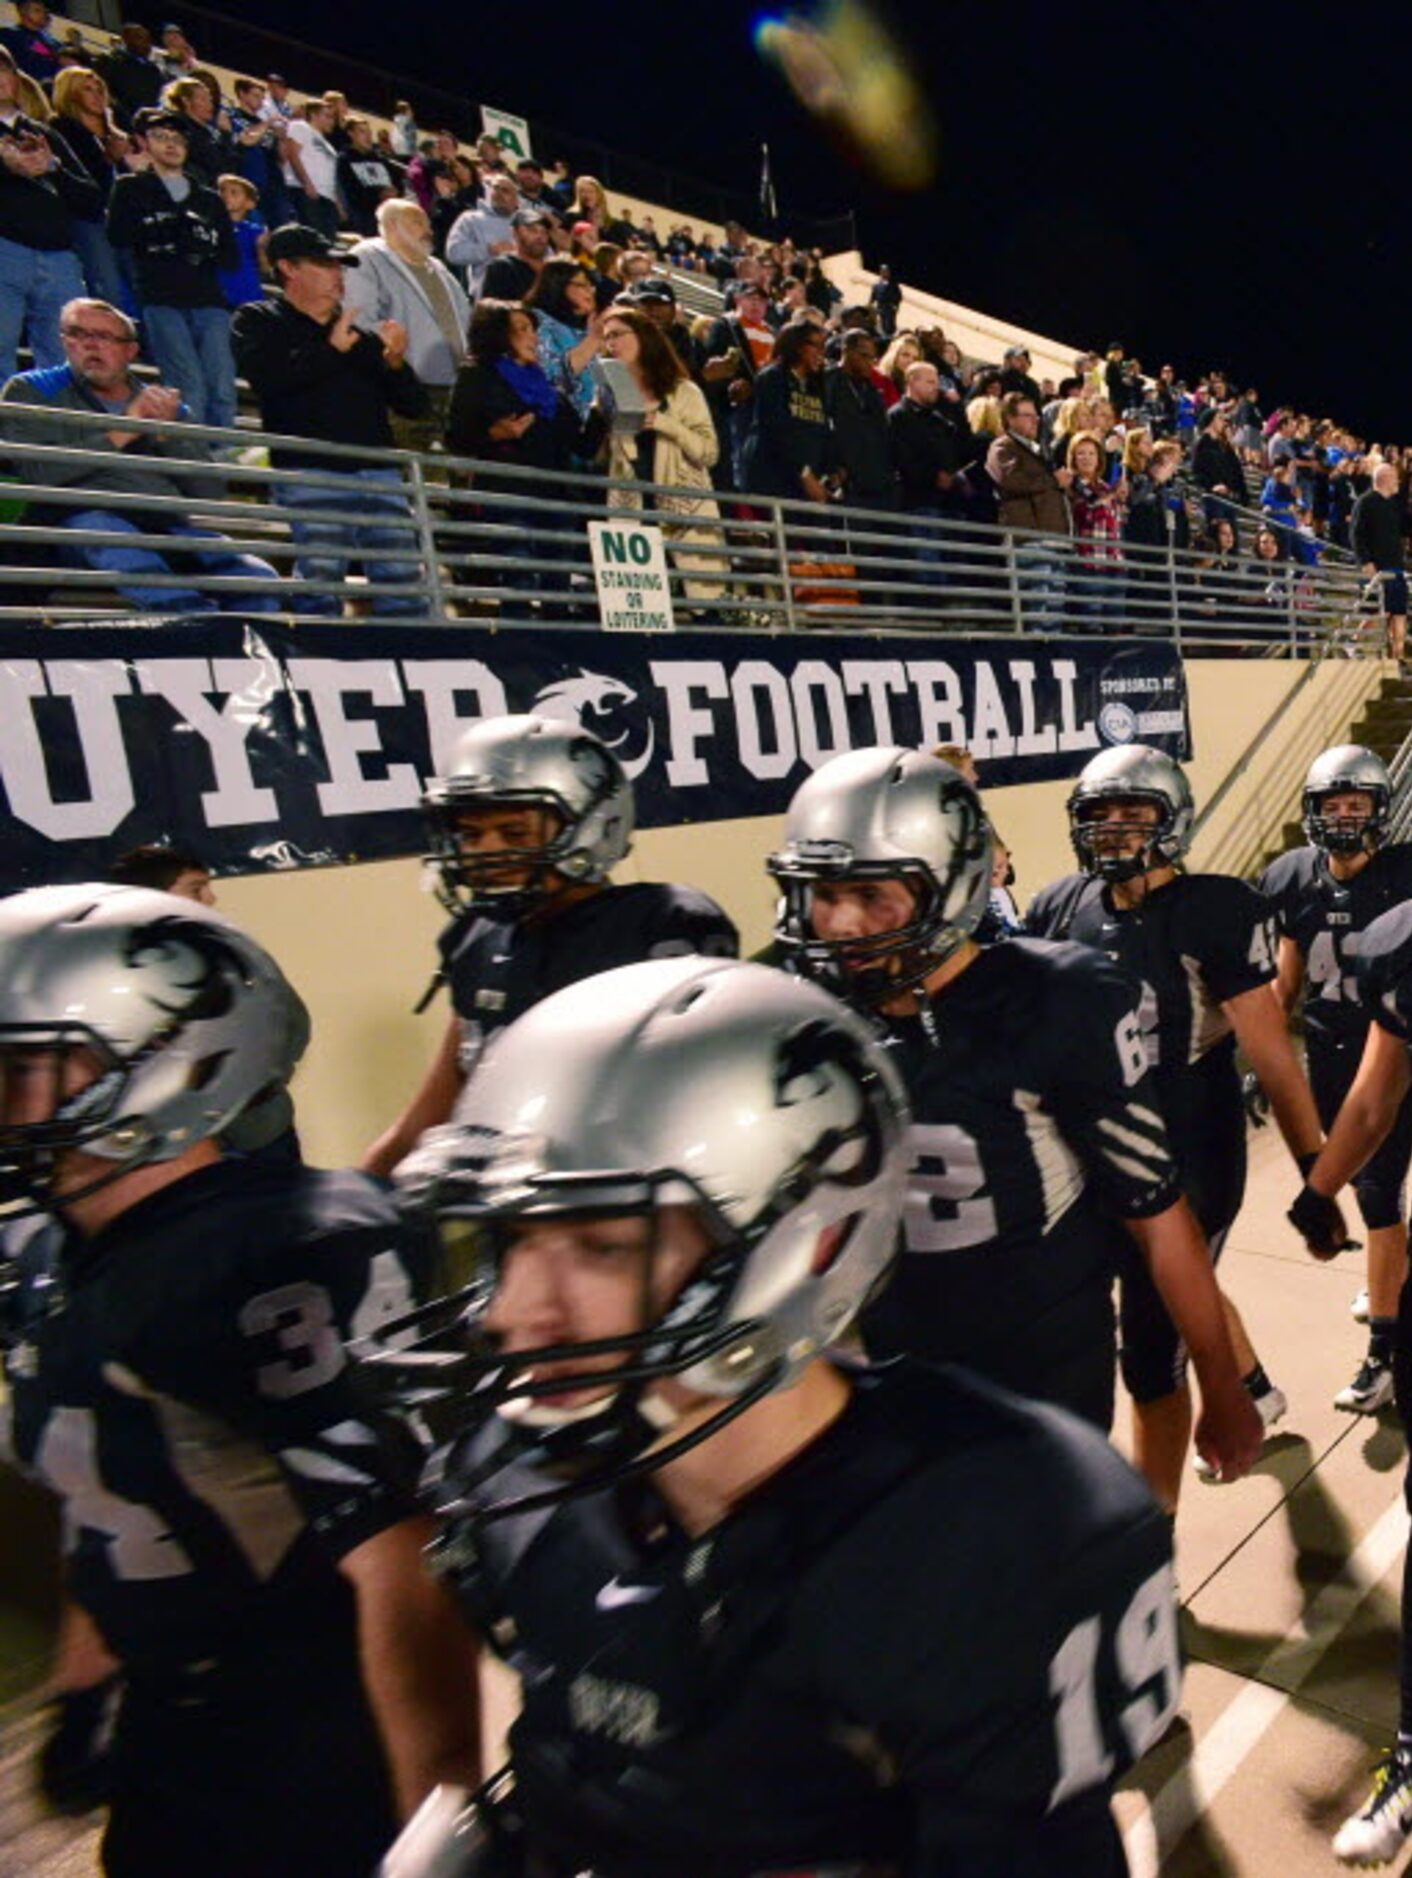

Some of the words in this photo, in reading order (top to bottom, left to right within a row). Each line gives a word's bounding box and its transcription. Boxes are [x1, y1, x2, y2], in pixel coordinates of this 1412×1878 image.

[601, 531, 651, 566] NO
[601, 570, 663, 591] STANDING
[626, 591, 643, 609] OR
[606, 611, 669, 629] LOITERING
[648, 660, 1100, 787] FOOTBALL
[1047, 1563, 1181, 1812] 19
